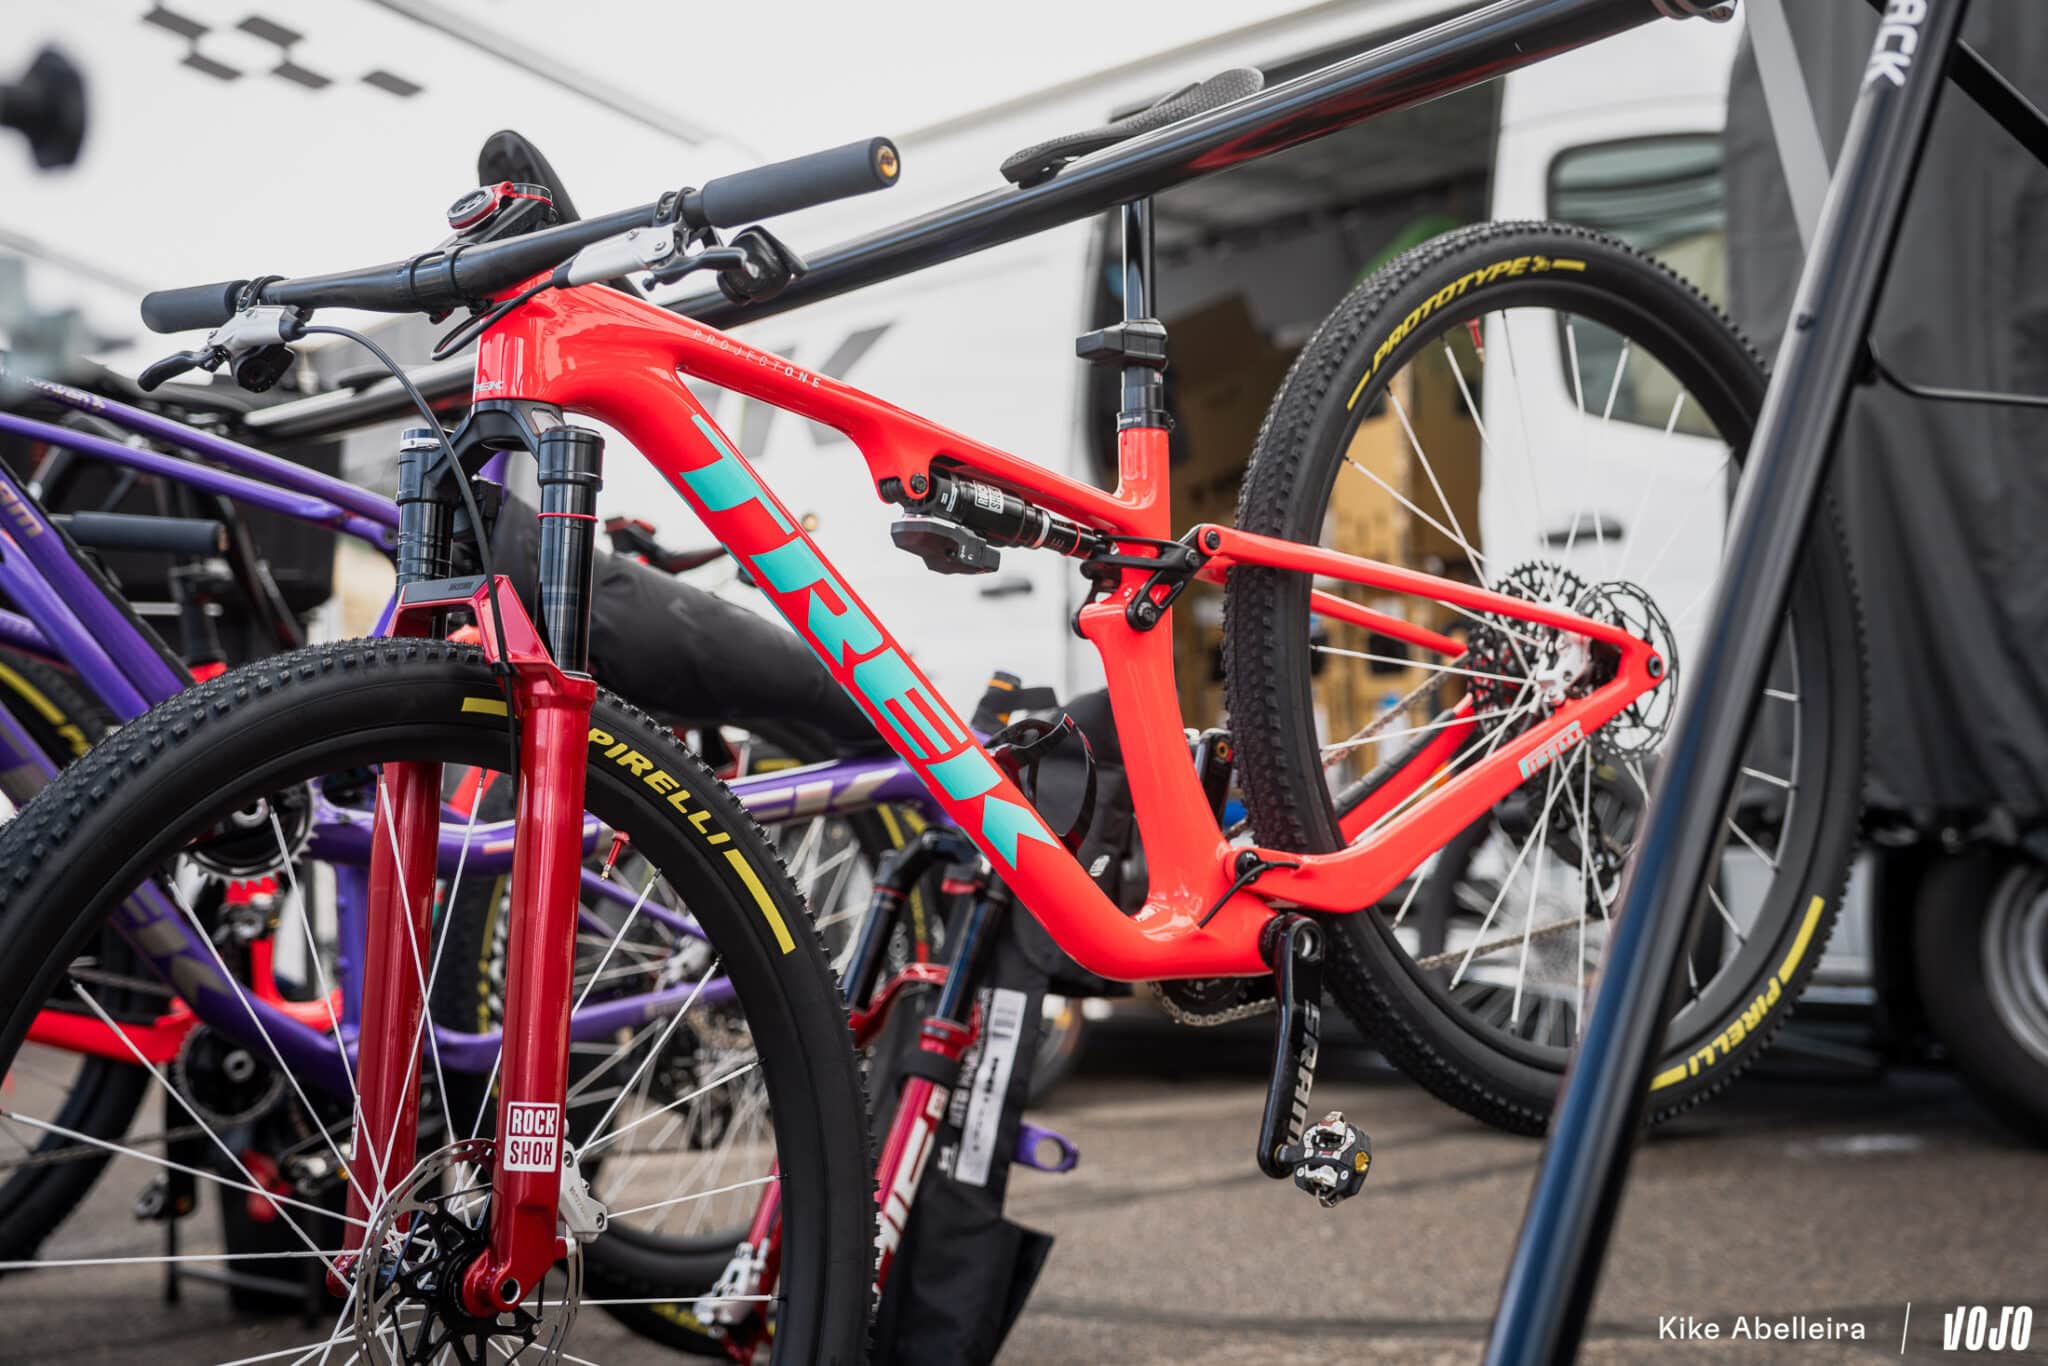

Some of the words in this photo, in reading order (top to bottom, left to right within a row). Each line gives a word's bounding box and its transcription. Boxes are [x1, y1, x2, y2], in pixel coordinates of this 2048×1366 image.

[1373, 256, 1531, 374] PROTOTYPE
[679, 413, 1061, 871] TREK
[588, 727, 732, 846] PIRELLI
[1687, 976, 1782, 1077] PIRELLI
[509, 1140, 553, 1166] SHOX
[511, 1108, 556, 1136] ROCK
